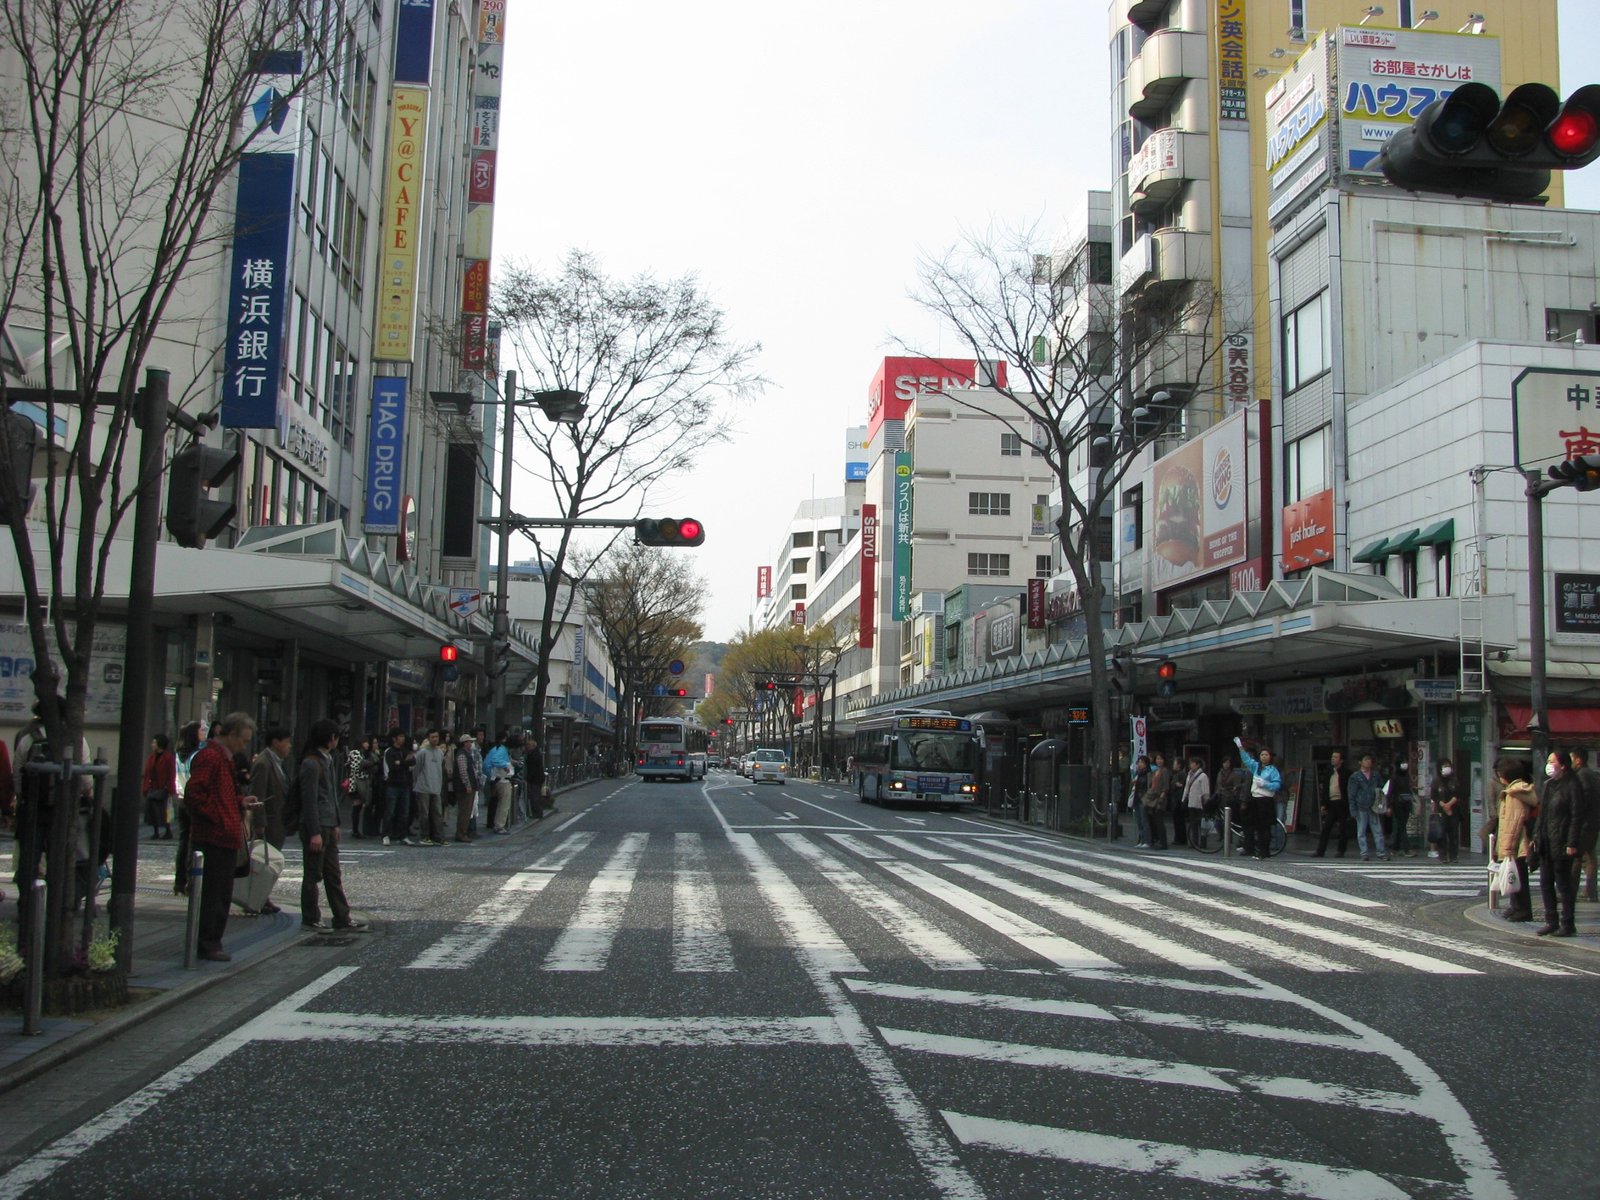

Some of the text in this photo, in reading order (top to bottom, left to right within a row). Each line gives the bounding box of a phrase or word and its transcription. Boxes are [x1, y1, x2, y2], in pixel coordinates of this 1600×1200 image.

[1220, 0, 1243, 79] ン英会話
[1350, 34, 1390, 45] いい部屋ネット
[1373, 60, 1472, 80] お部屋さがしは
[1343, 82, 1453, 118] ハウス
[1266, 90, 1325, 171] ハウスコム
[235, 259, 274, 397] 横浜銀行
[1231, 337, 1244, 346] 3F
[1567, 384, 1600, 411] 中
[373, 391, 398, 511] HAC DRUG
[1214, 466, 1232, 497] KING
[863, 516, 876, 558] SEIYU
[1228, 531, 1237, 542] THE
[1303, 519, 1316, 539] hair
